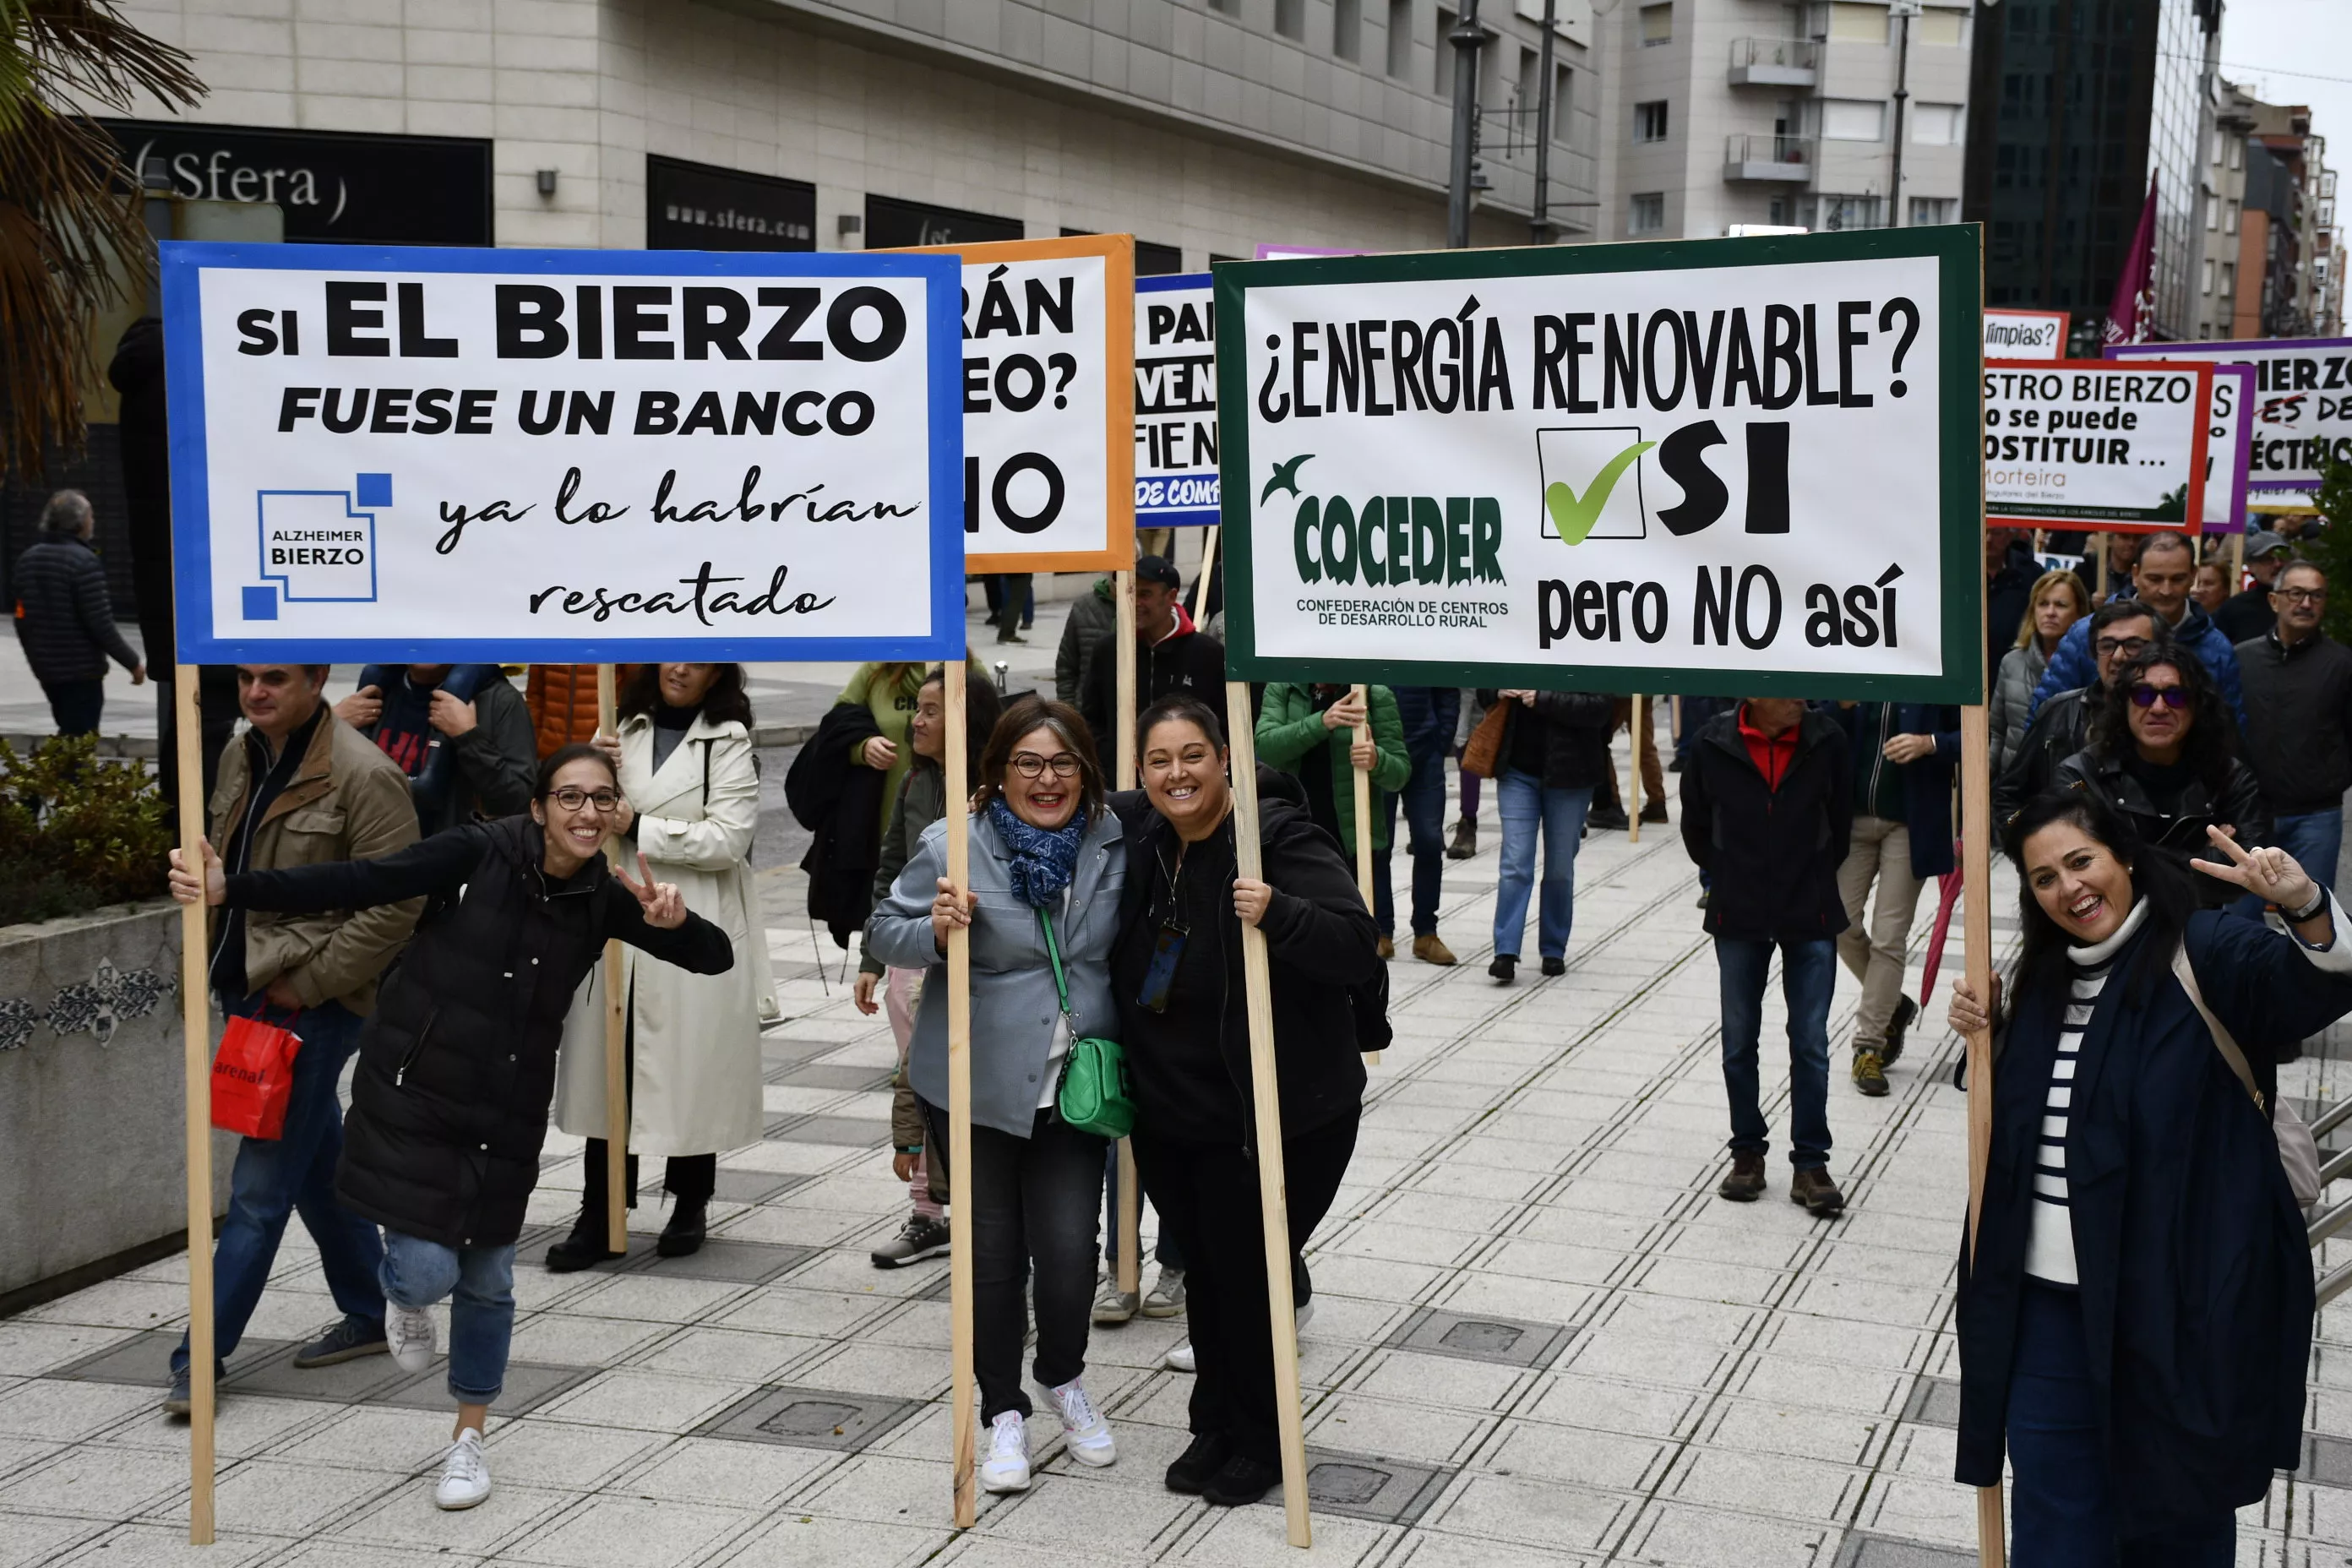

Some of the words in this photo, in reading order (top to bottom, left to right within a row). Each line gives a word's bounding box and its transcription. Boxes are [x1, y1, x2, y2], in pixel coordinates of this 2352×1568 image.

[667, 204, 810, 241] www.sfera.com
[237, 309, 298, 356] SI
[325, 281, 458, 357] EL
[496, 285, 906, 362] BIERZO
[1259, 294, 1514, 423] ¿ENERGÍA
[1533, 297, 1919, 413] RENOVABLE?
[278, 388, 498, 434] FUESE
[519, 390, 615, 435] UN
[634, 391, 874, 436] BANCO
[2073, 376, 2191, 404] BIERZO
[2009, 410, 2039, 427] se
[2048, 406, 2137, 433] puede
[1657, 420, 1789, 536] SI
[436, 501, 537, 554] ya
[555, 467, 631, 524] lo
[651, 466, 922, 524] habrían
[272, 548, 363, 564] BIERZO
[273, 531, 363, 542] ALZHEIMER
[1293, 494, 1507, 588] COCEDER
[530, 562, 836, 626] rescatado
[1297, 598, 1415, 614] CONFEDERACIÓN
[1419, 602, 1437, 613] DE
[1440, 602, 1509, 615] CENTROS
[1538, 580, 1668, 649] pero
[1693, 564, 1782, 650] NO
[1805, 563, 1904, 647] así
[1319, 613, 1337, 625] DE
[1341, 613, 1435, 627] DESARROLLO
[1440, 615, 1488, 628] RURAL
